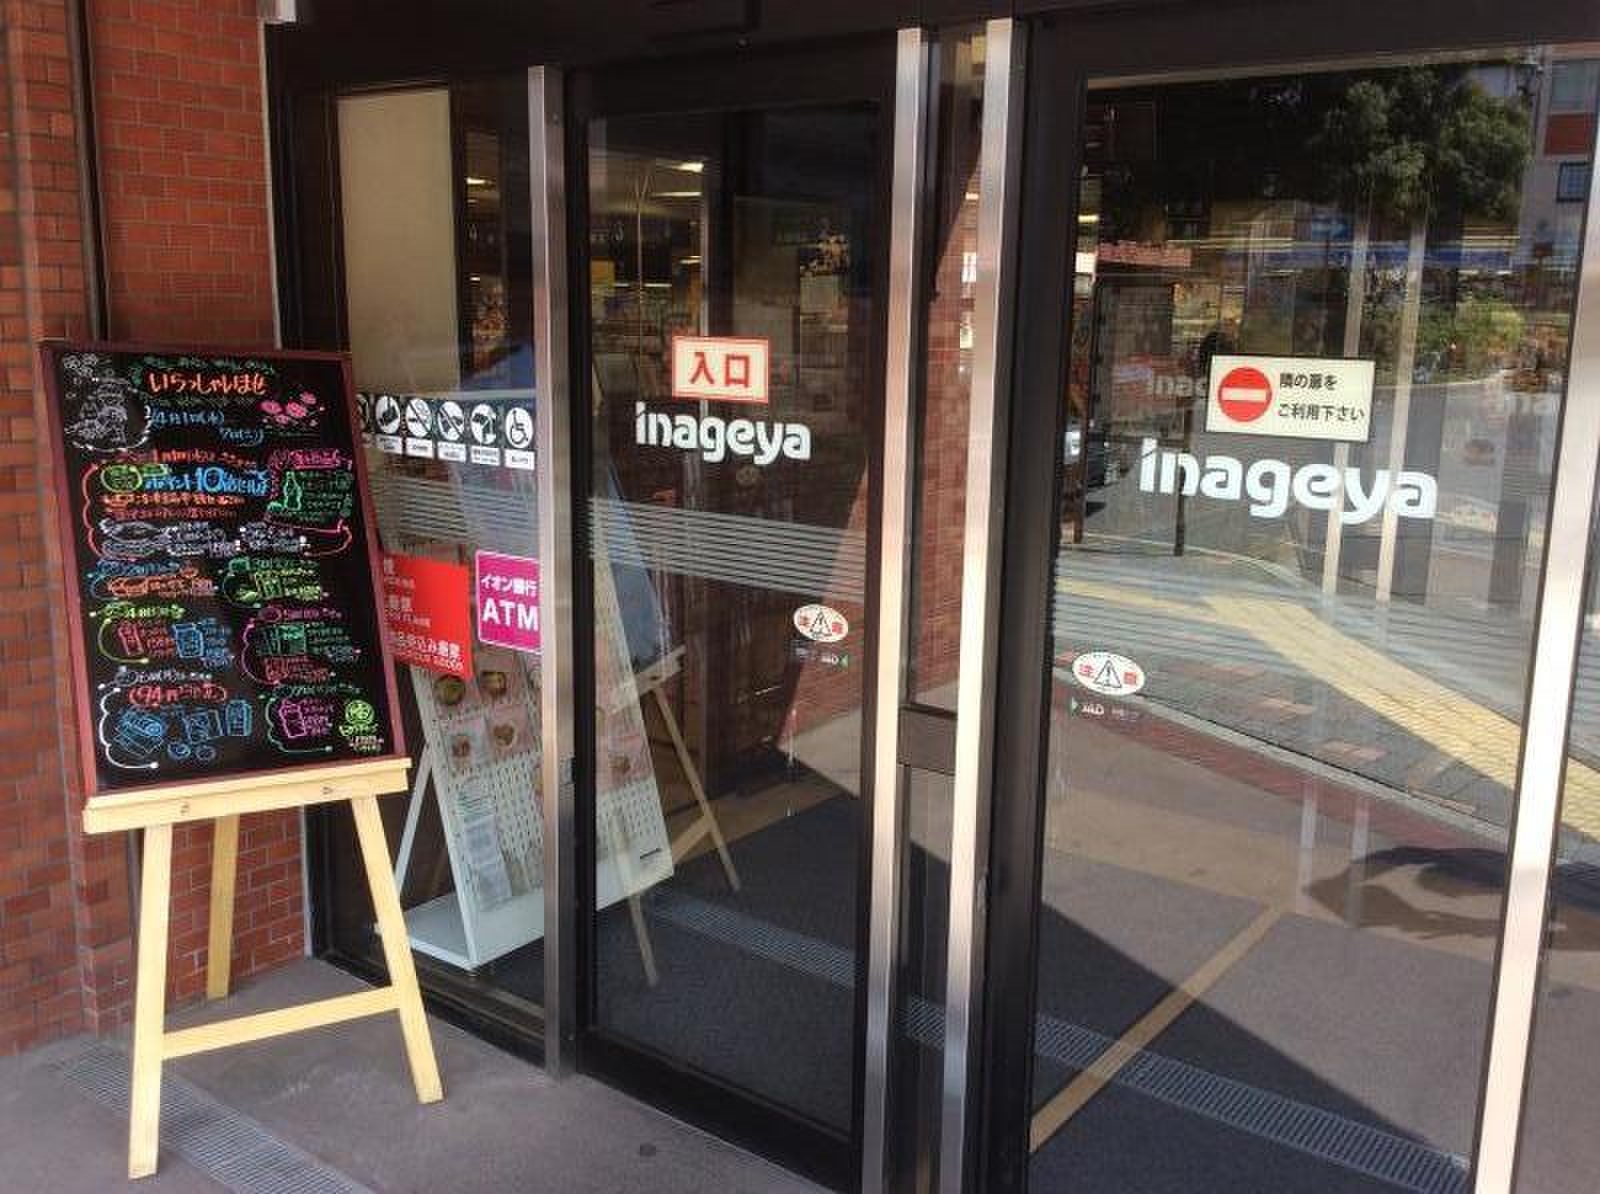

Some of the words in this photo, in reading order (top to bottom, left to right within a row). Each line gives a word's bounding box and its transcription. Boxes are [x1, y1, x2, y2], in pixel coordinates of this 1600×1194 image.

[690, 351, 751, 388] 入口
[1278, 403, 1365, 422] ご利用下さい
[635, 401, 811, 465] inageya
[1139, 438, 1438, 525] inageya
[482, 597, 540, 632] ATM
